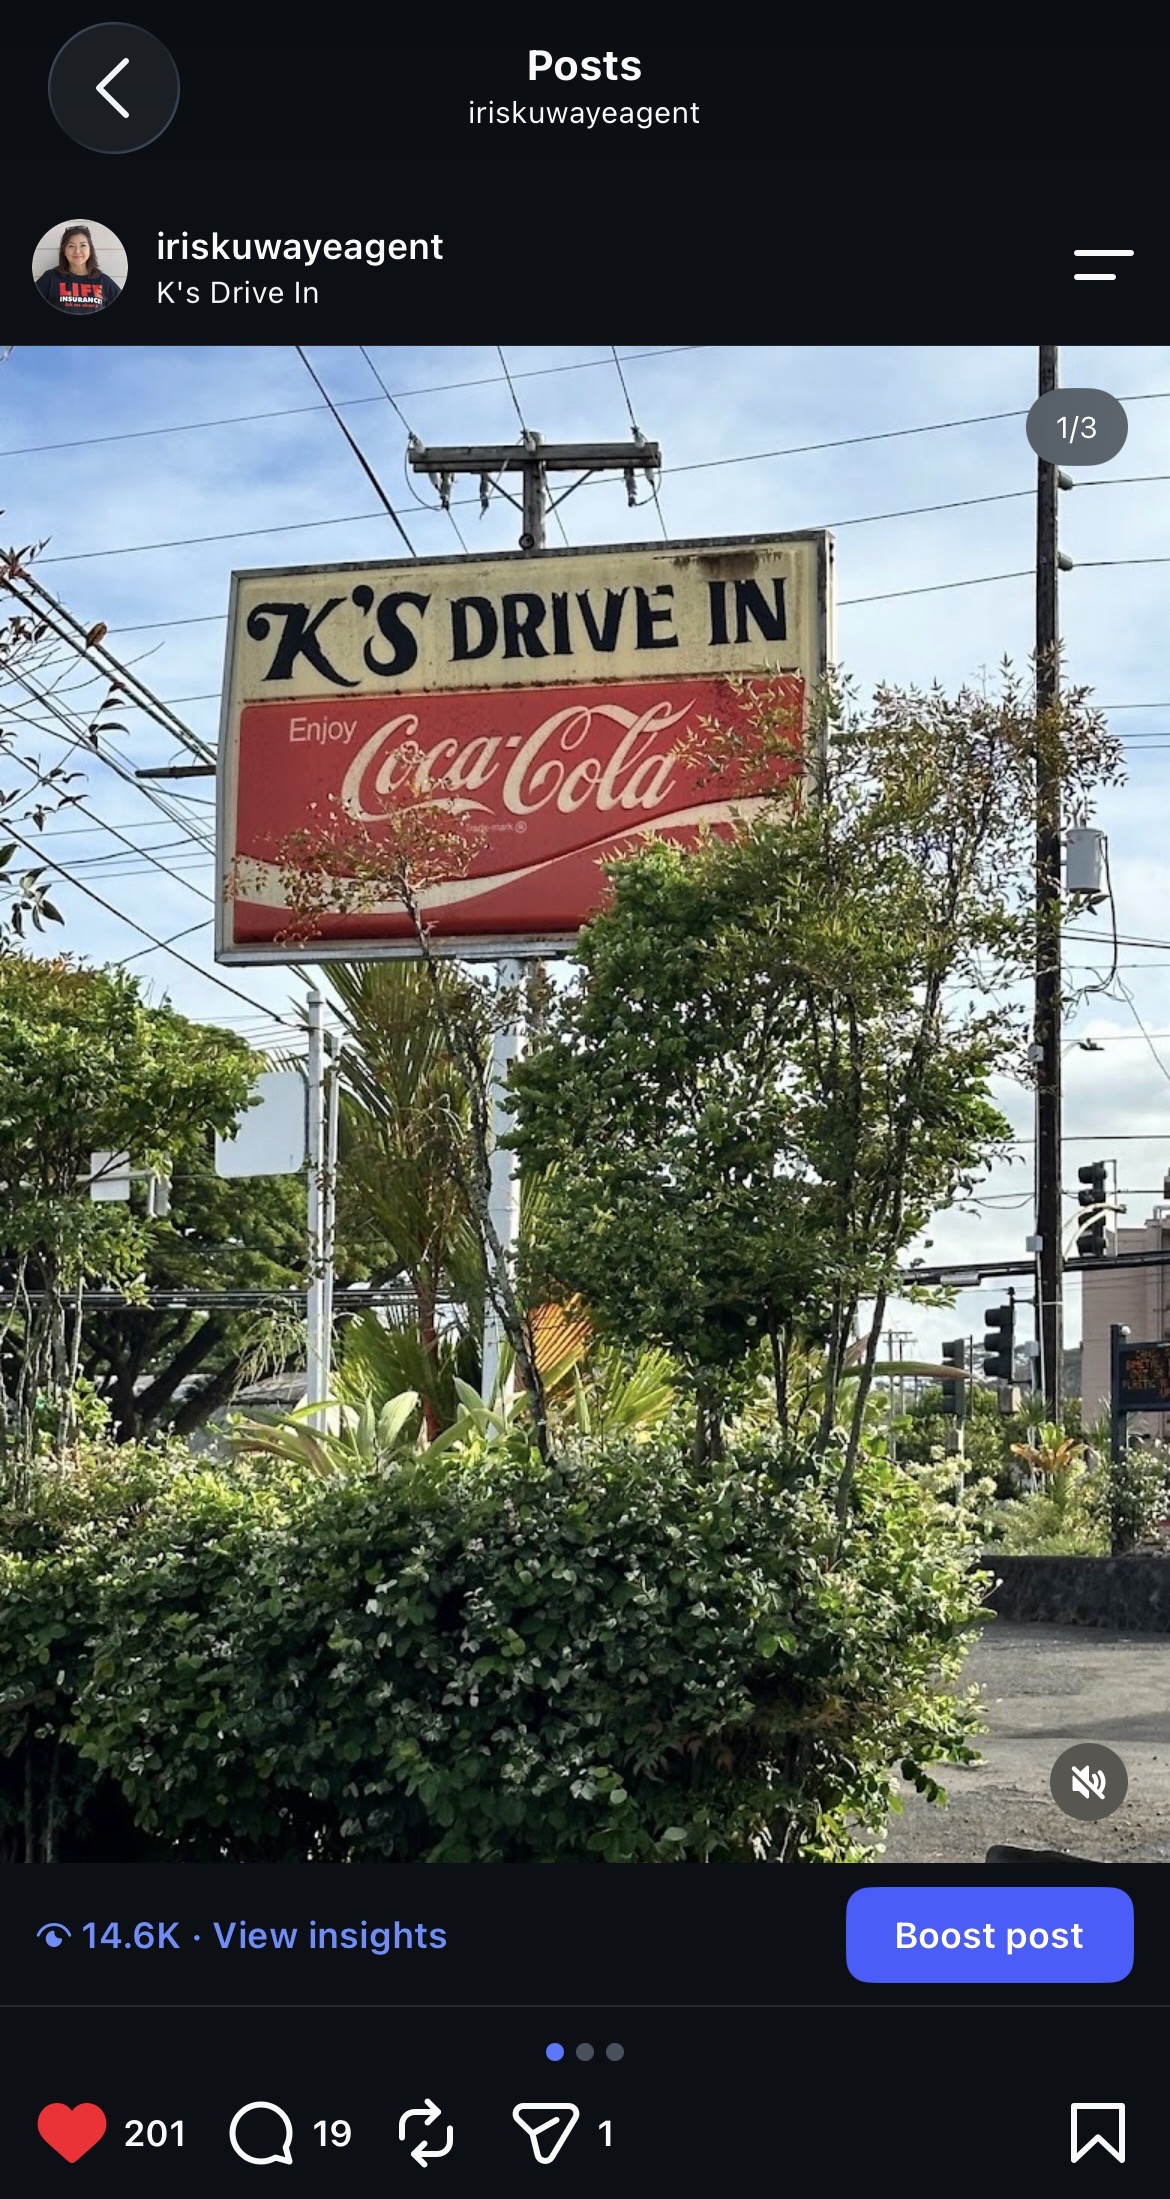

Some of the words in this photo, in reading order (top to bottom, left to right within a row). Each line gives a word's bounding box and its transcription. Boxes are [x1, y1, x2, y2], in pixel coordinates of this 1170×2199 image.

[59, 282, 103, 299] LIFE
[247, 585, 431, 687] K'S
[449, 585, 679, 662] DRIVE
[708, 577, 788, 647] IN
[289, 716, 357, 745] Enjoy
[341, 698, 697, 824] Coca-Cola
